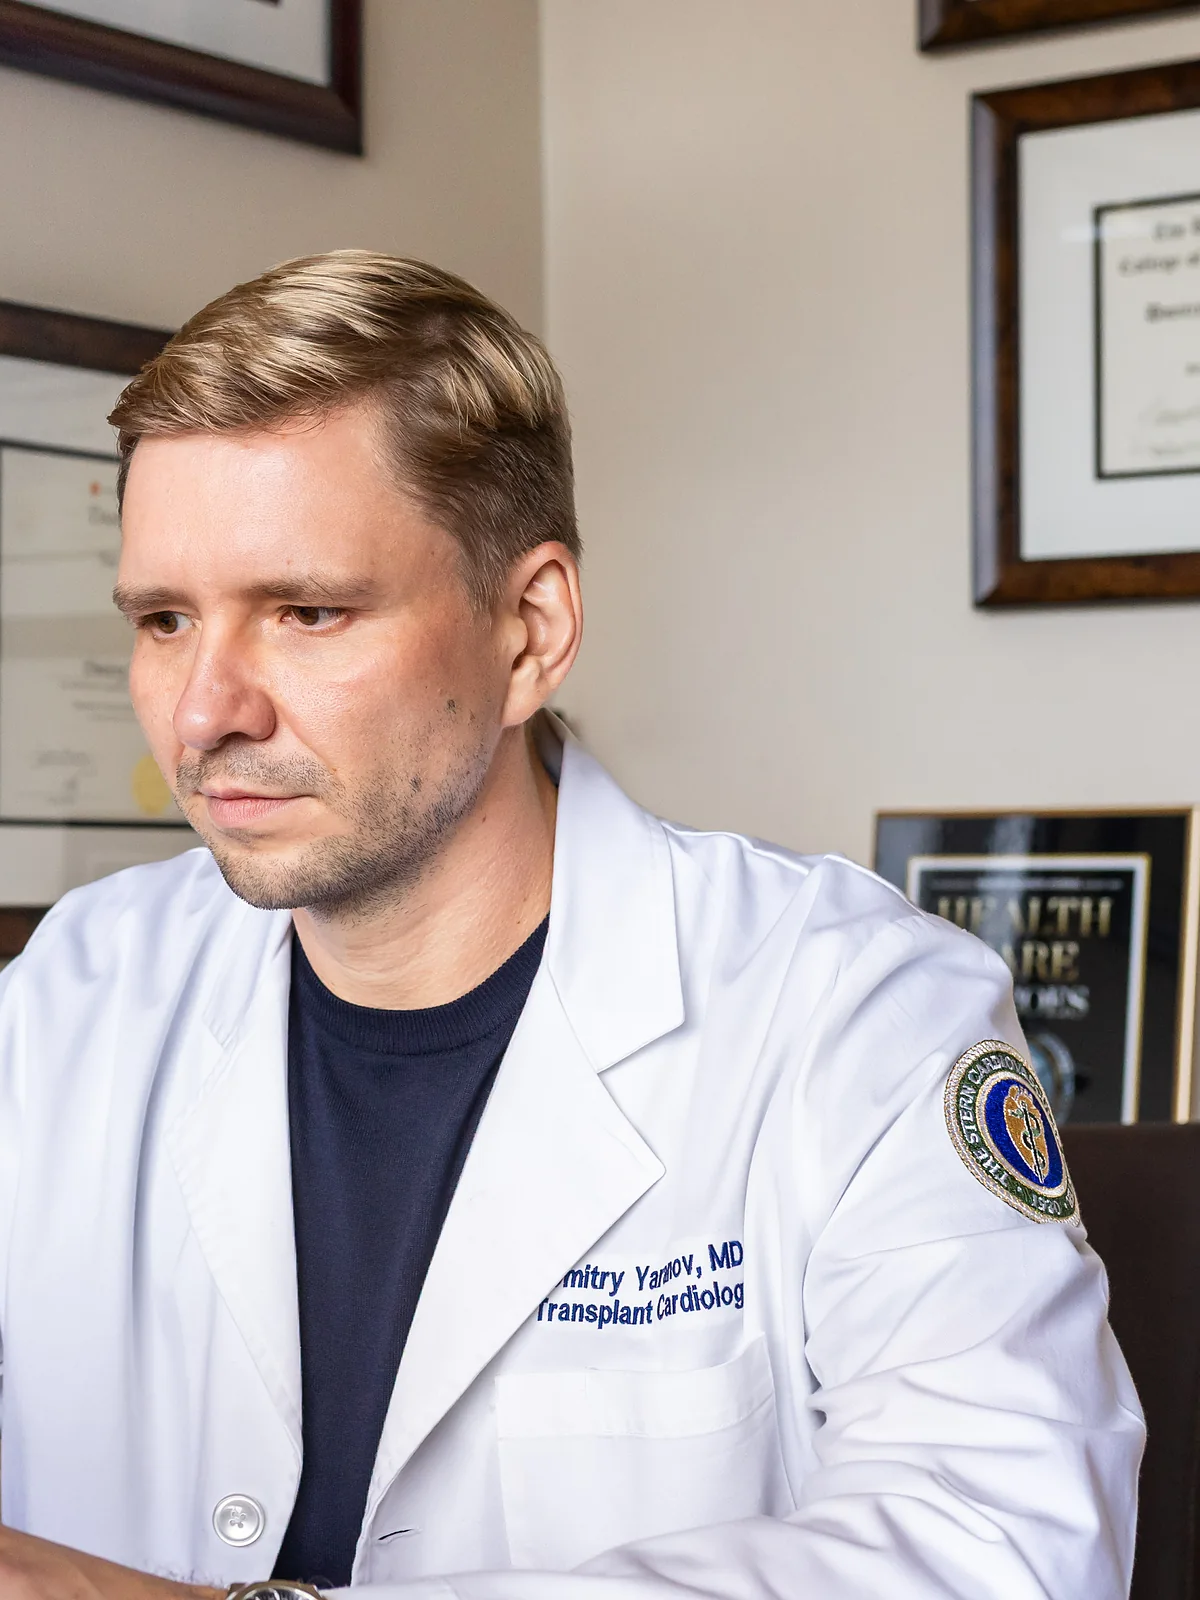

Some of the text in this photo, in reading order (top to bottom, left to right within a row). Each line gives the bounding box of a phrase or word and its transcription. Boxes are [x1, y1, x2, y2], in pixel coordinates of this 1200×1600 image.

[1001, 940, 1081, 981] ARE
[959, 1083, 979, 1145] STERN
[973, 1146, 1008, 1188] THE
[560, 1263, 626, 1297] mitry
[707, 1240, 744, 1272] MD
[536, 1281, 745, 1330] Transplant Cardiolog
